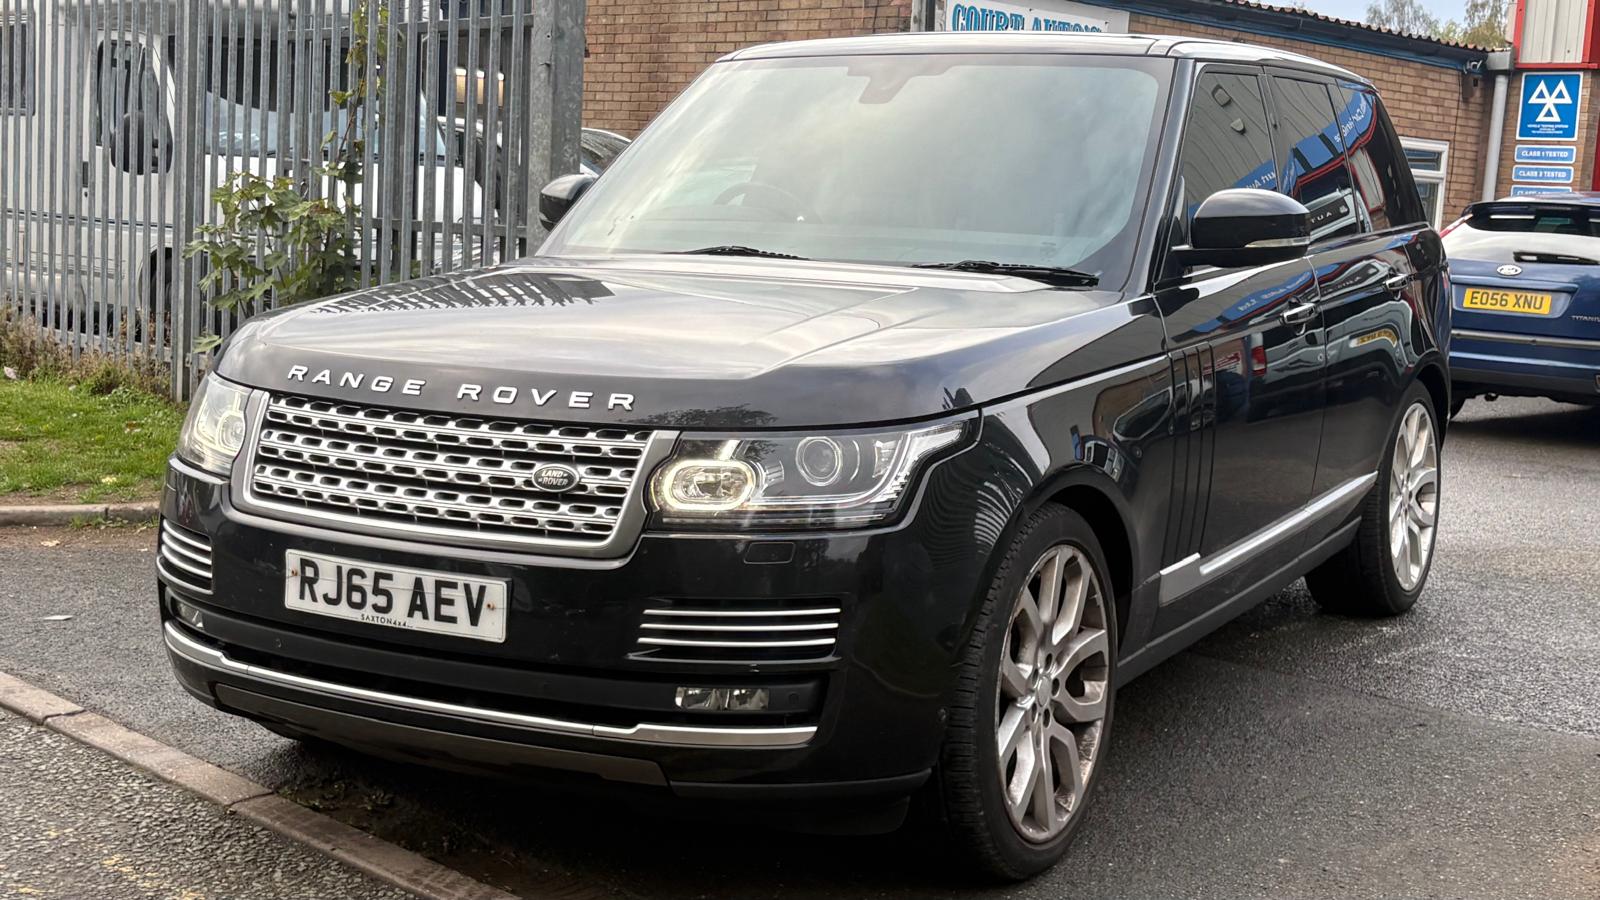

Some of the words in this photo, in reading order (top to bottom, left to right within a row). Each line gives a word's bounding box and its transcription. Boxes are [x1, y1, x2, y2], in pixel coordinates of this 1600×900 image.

[952, 3, 1025, 31] COURT
[1469, 290, 1508, 307] EO56
[1512, 294, 1544, 310] XNU
[287, 365, 426, 396] RANGE
[456, 383, 635, 411] ROVER
[541, 469, 563, 477] LAND
[542, 477, 568, 486] ROVER
[299, 557, 394, 614] RJ65
[407, 576, 487, 627] AEV
